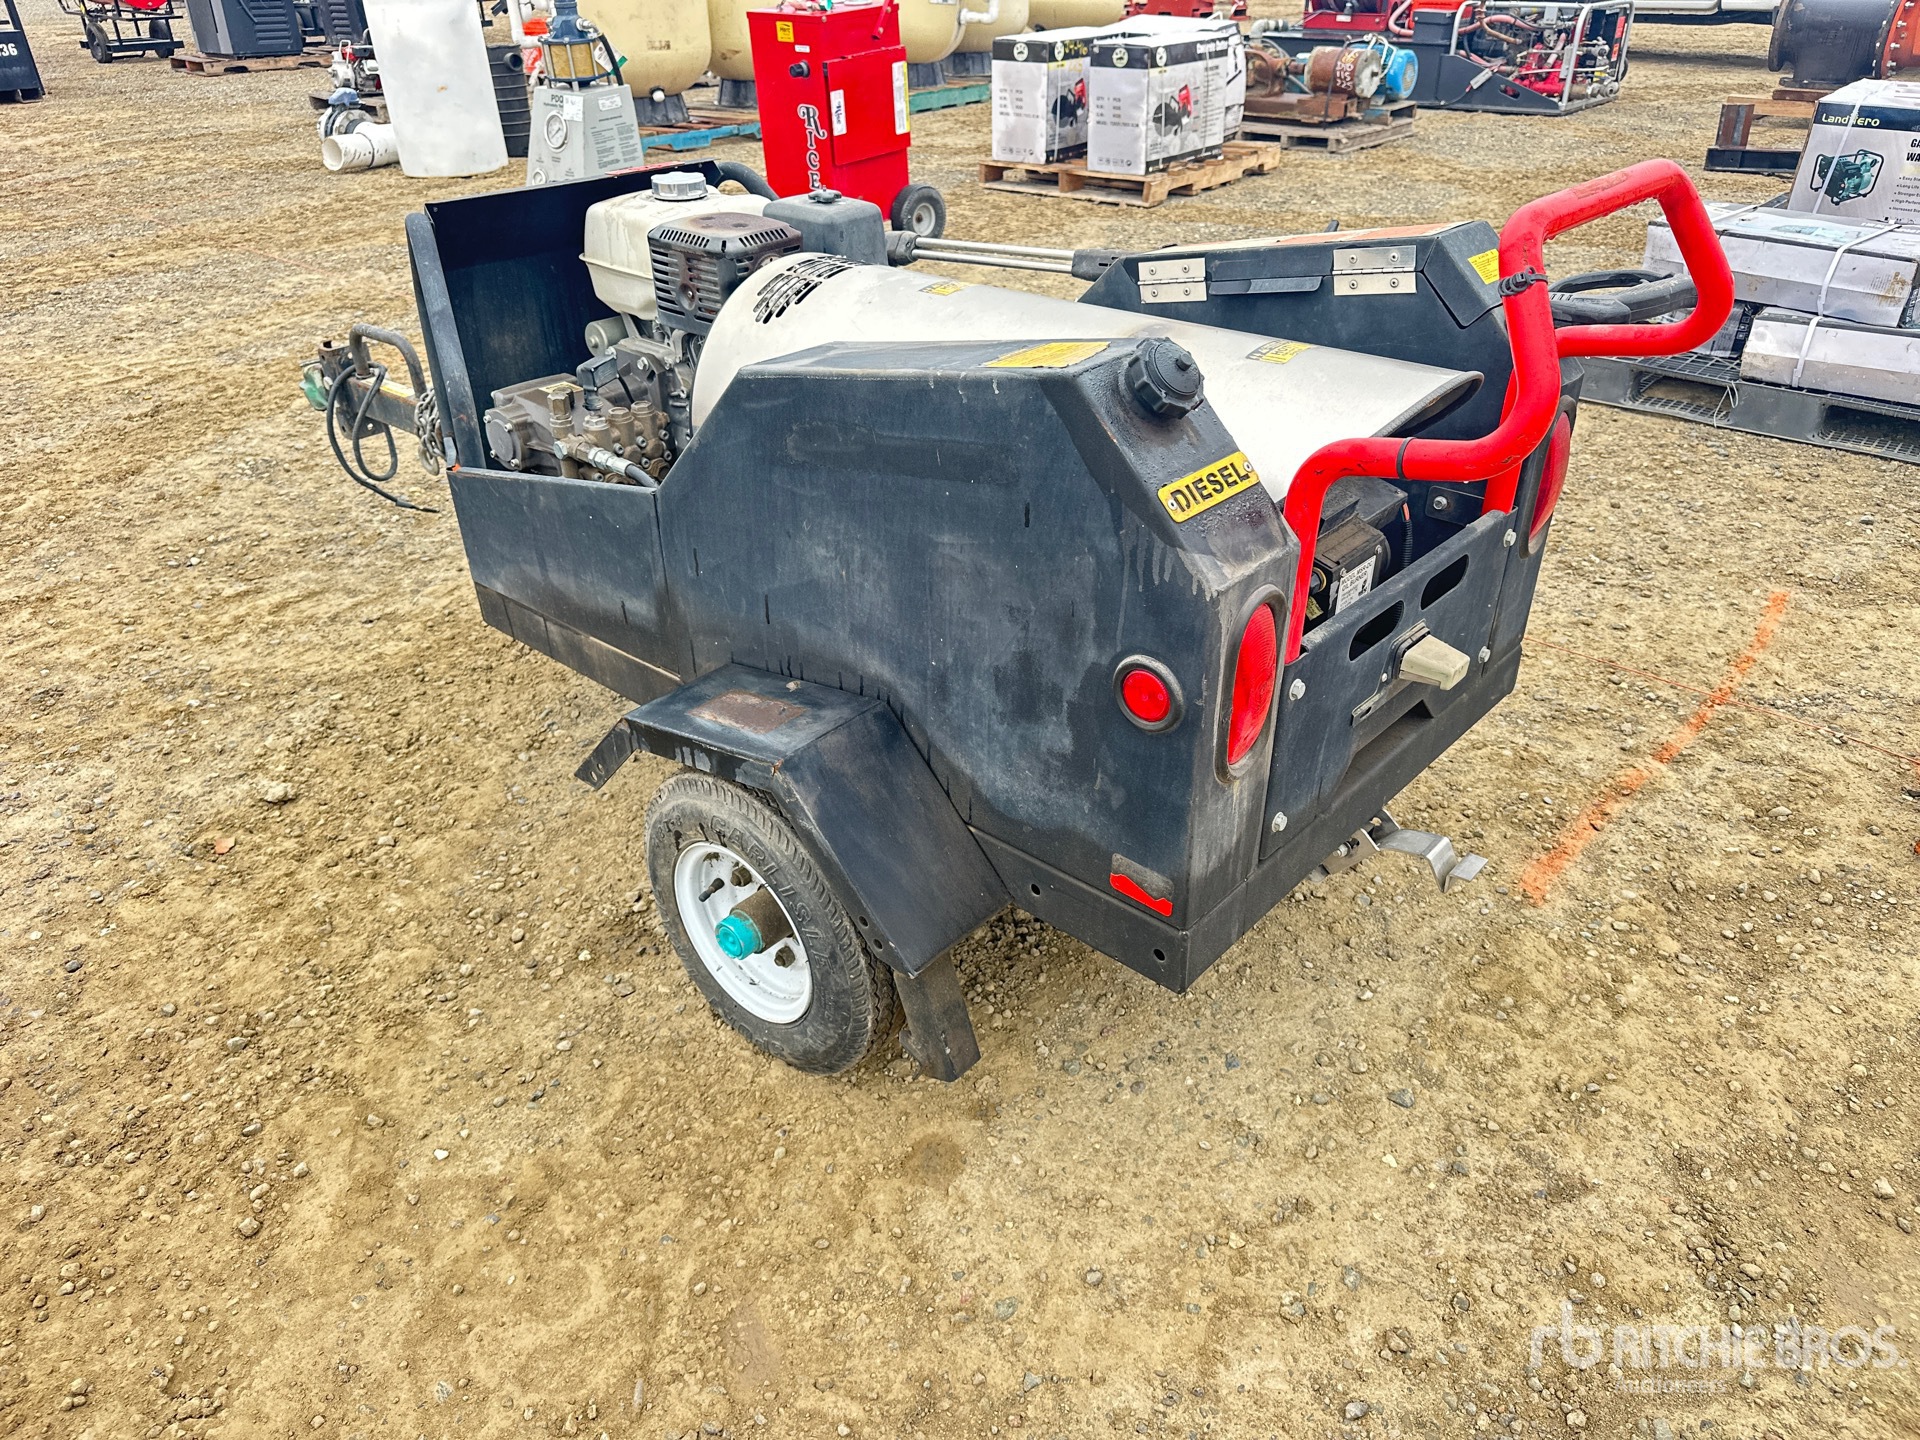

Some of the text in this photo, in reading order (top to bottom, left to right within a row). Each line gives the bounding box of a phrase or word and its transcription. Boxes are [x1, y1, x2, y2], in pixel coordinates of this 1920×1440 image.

[797, 103, 828, 190] RICE
[1170, 462, 1251, 513] DIESEL
[710, 814, 834, 970] CARLISLE
